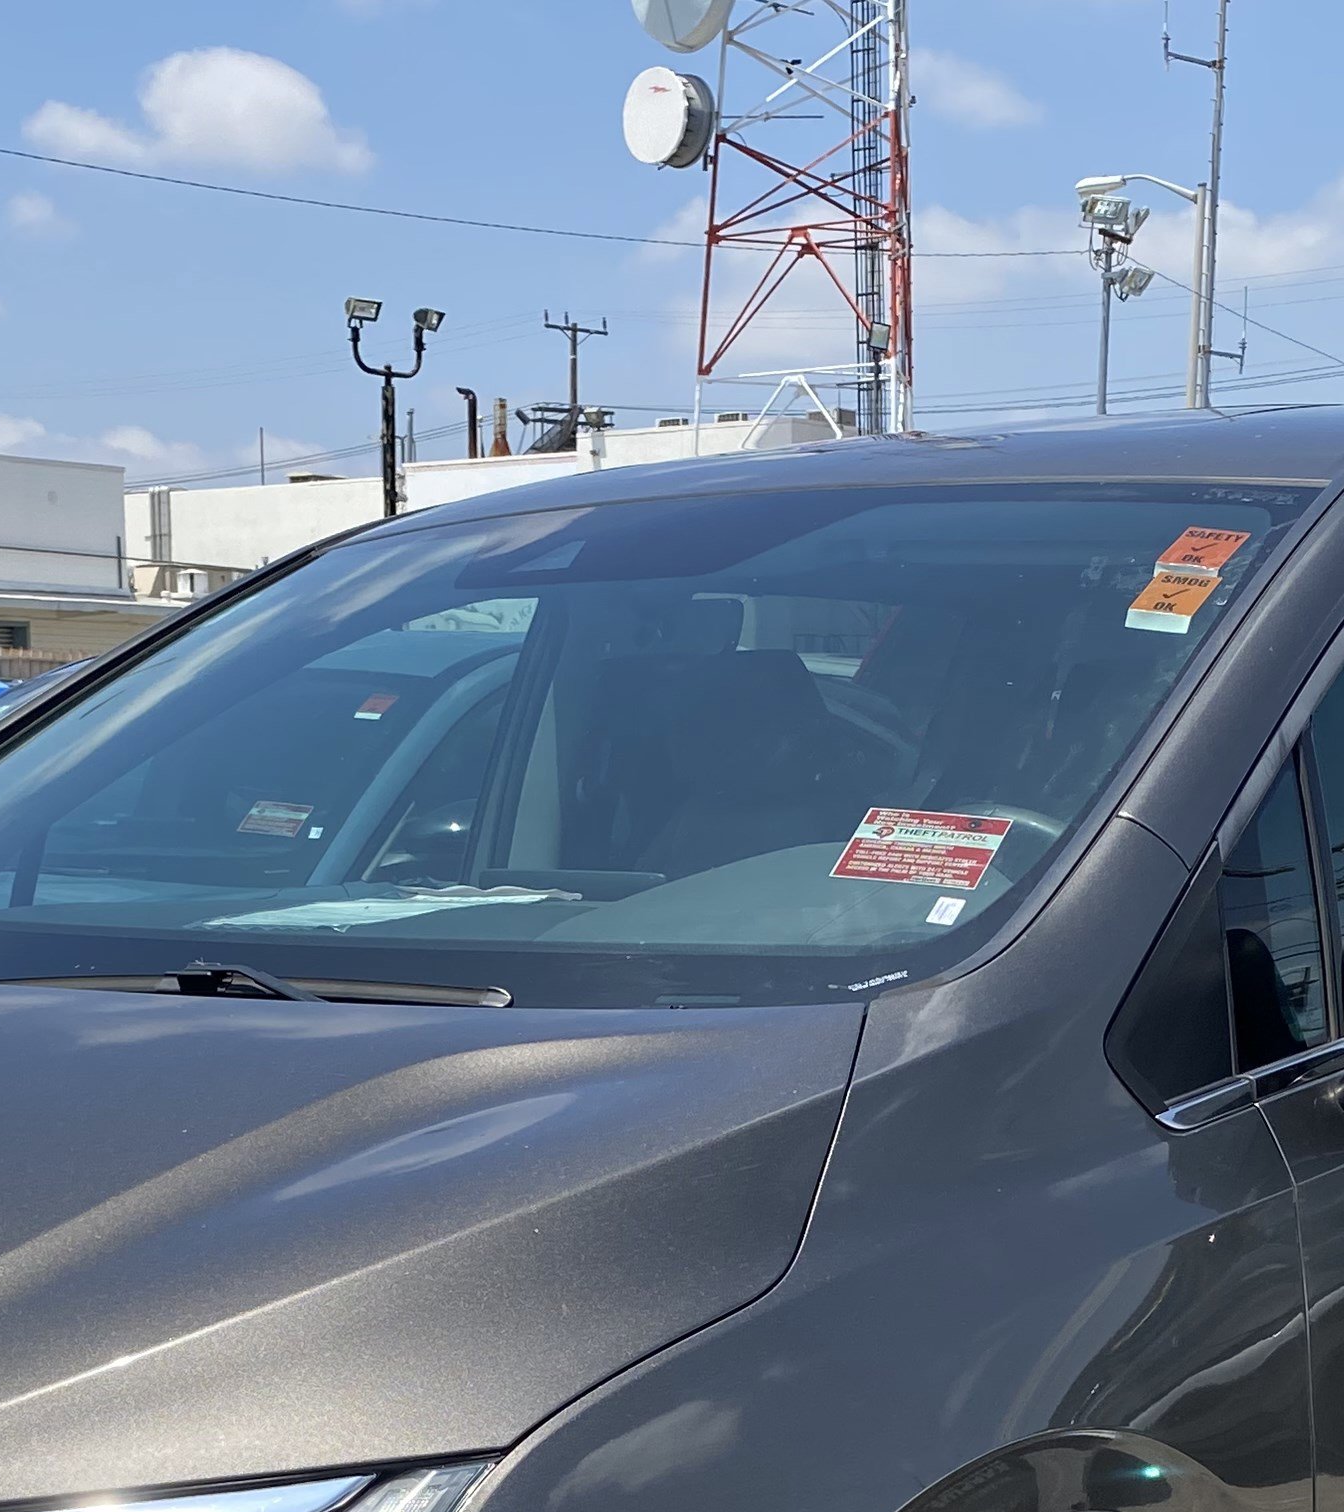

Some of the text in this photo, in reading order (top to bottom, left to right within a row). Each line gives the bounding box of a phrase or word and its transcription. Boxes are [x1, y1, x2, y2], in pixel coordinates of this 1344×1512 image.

[1185, 529, 1244, 543] SAFETY
[1181, 554, 1205, 563] OK
[1161, 575, 1211, 588] SMOG
[1152, 601, 1177, 612] OK
